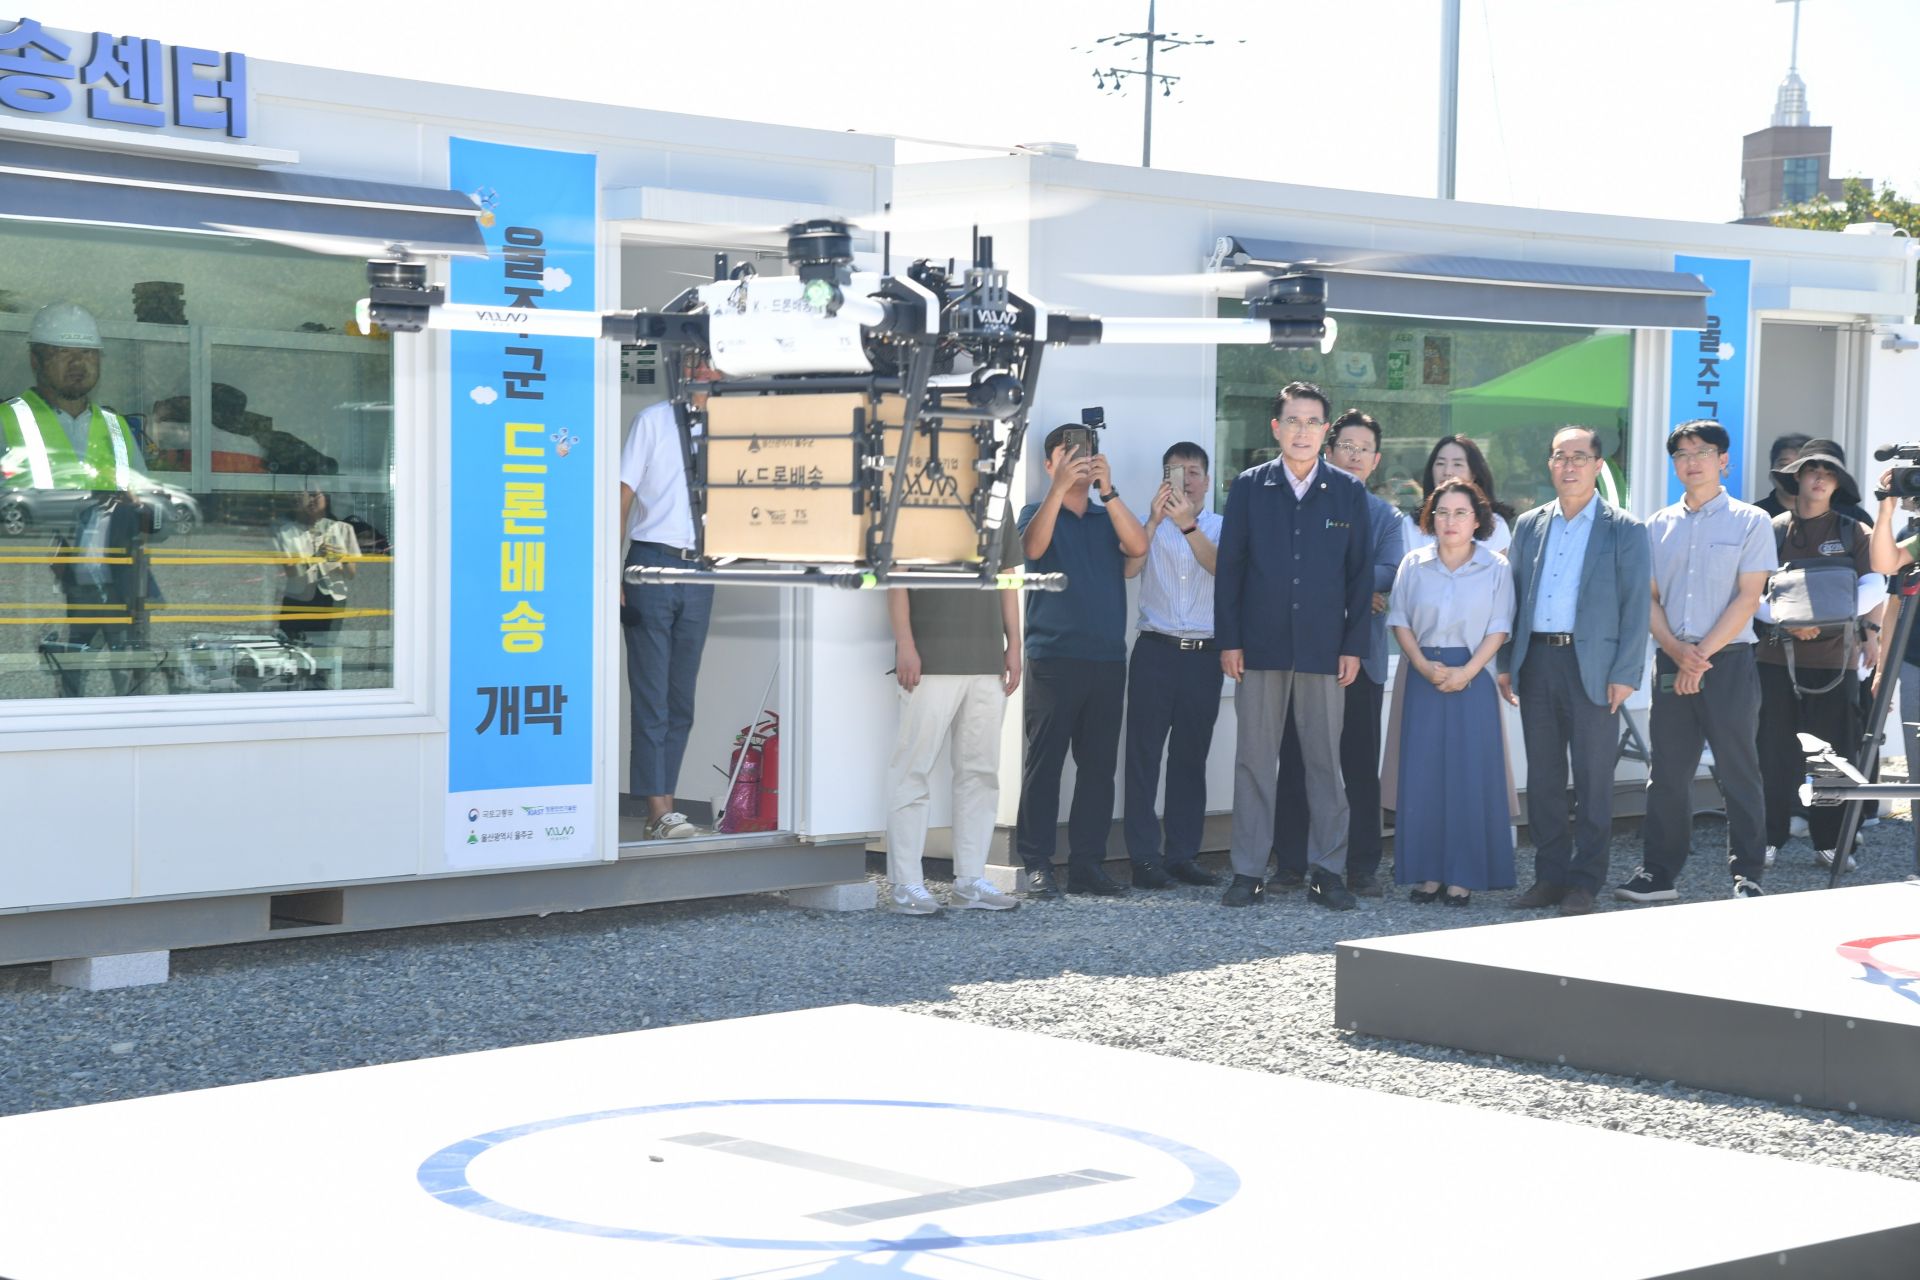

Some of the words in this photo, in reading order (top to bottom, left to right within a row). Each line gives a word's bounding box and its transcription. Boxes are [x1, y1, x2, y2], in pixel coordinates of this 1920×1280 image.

[0, 17, 247, 138] 송센터
[500, 422, 547, 653] 드론배송
[475, 684, 568, 736] 개막
